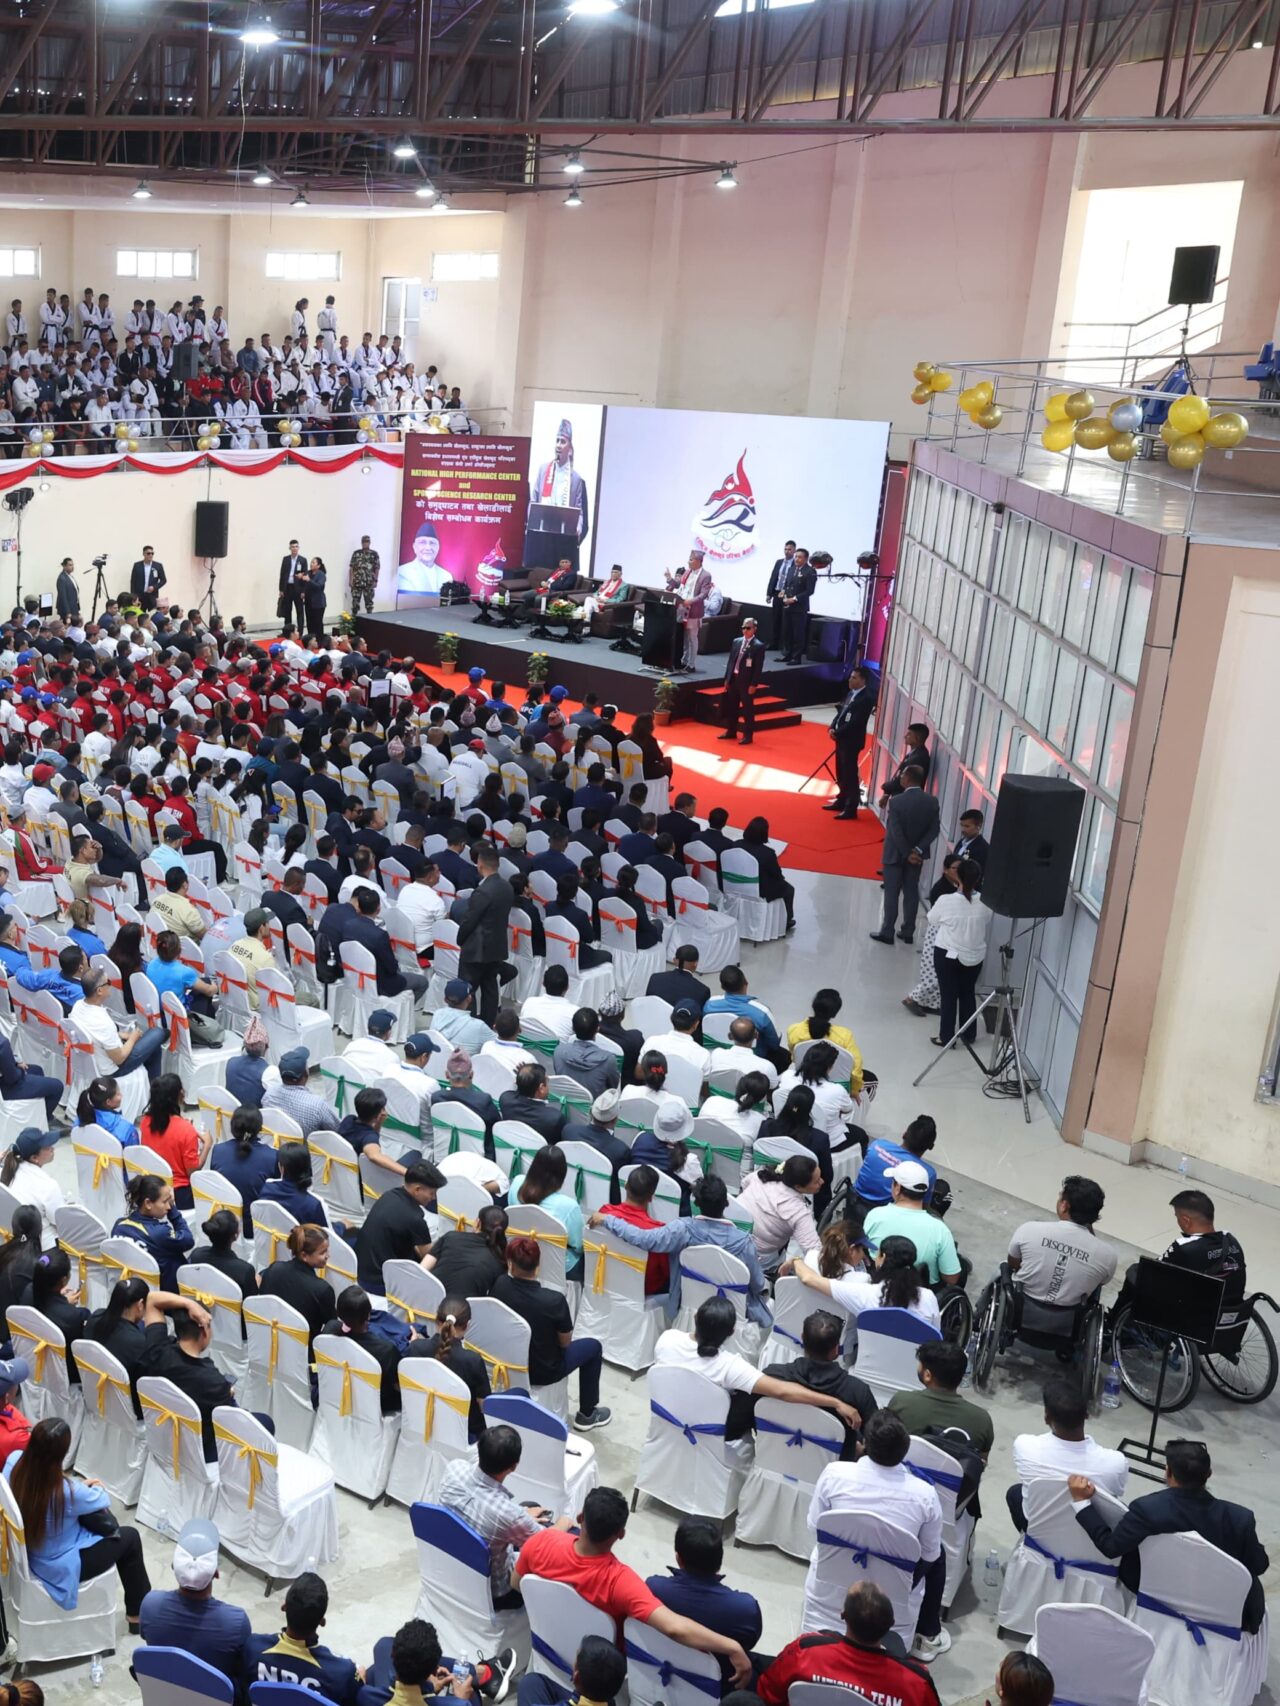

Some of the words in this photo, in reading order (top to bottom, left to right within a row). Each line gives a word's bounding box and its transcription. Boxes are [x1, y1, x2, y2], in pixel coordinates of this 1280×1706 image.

[411, 469, 439, 478] NATIONAL
[439, 470, 454, 478] HIGH
[455, 471, 498, 480] PERFORMANCE
[498, 473, 521, 481] CENTER
[462, 492, 492, 501] RESEARCH
[493, 493, 517, 501] CENTER
[1041, 1237, 1090, 1263] DISCOVER
